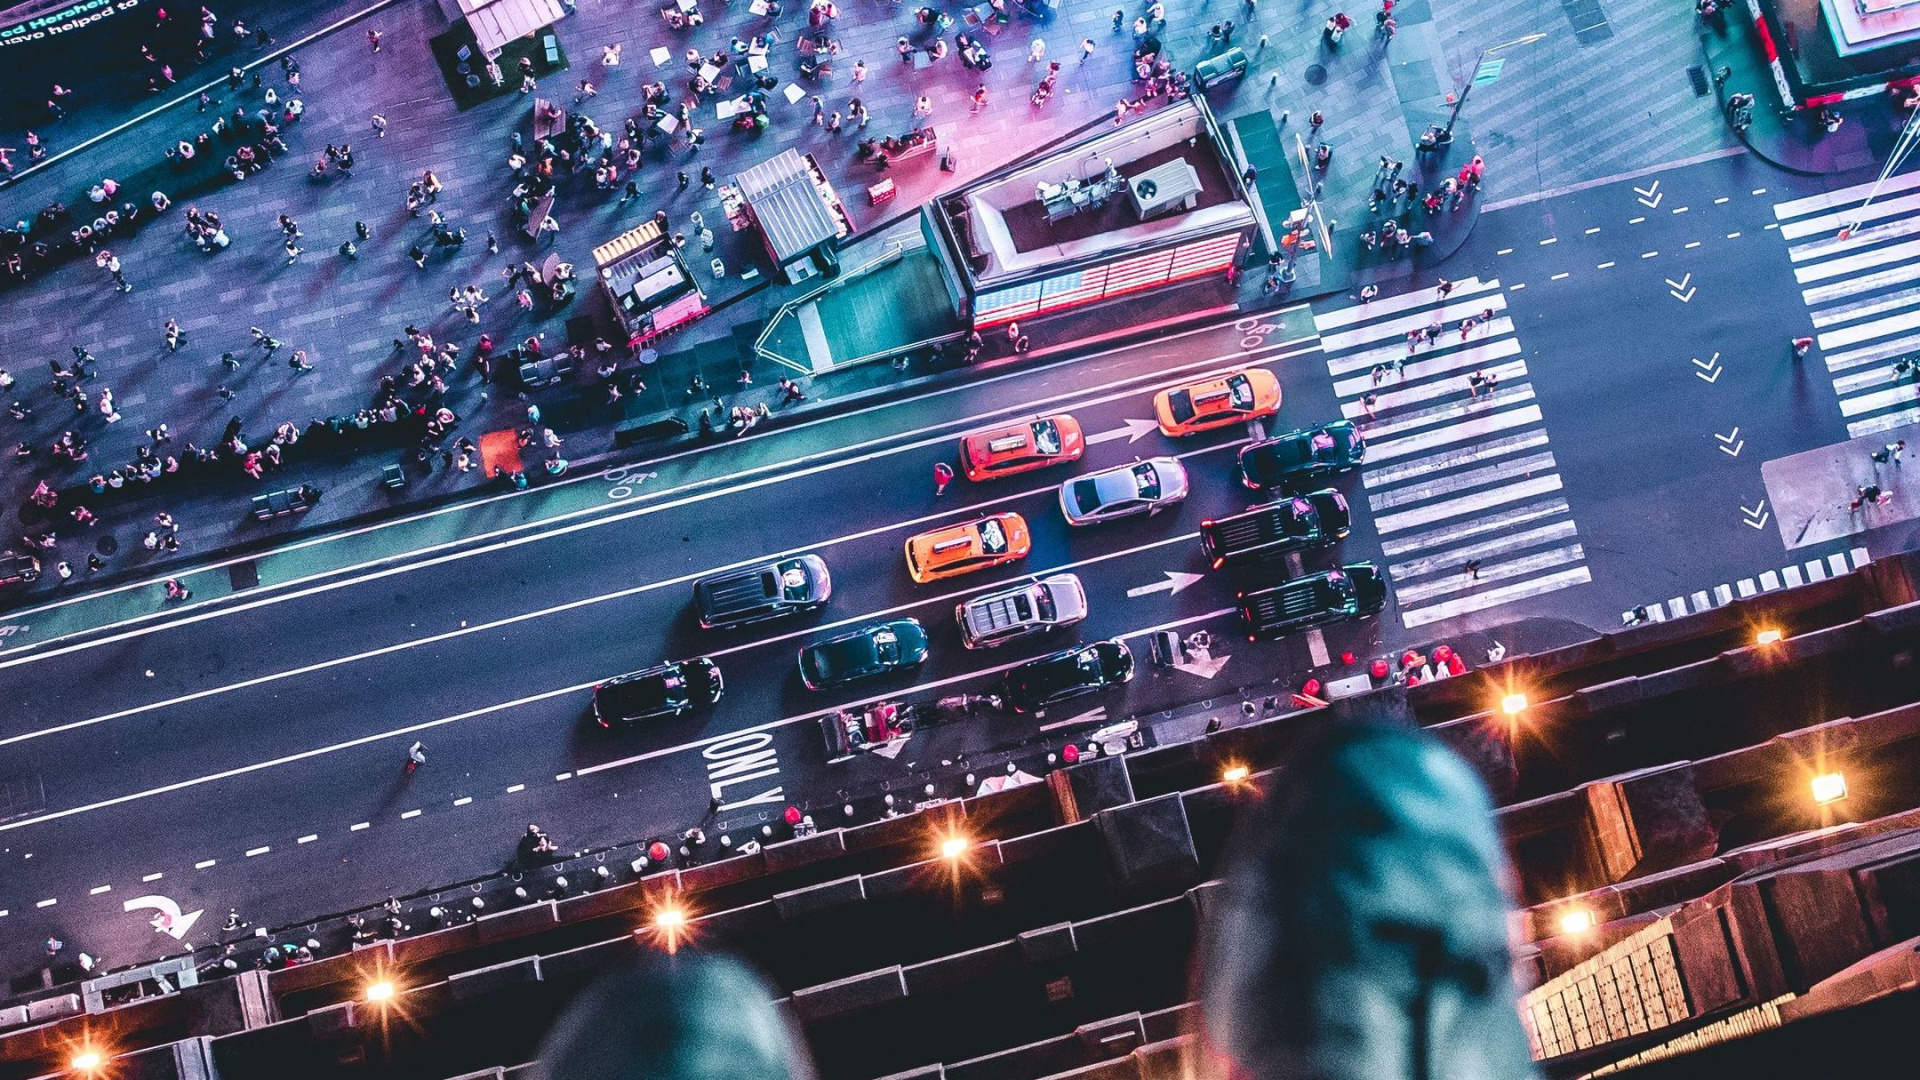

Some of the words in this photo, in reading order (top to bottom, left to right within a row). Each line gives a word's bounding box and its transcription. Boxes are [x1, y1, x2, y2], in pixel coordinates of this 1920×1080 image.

[47, 6, 115, 35] helped
[116, 0, 139, 10] to
[702, 732, 785, 812] ONLY
